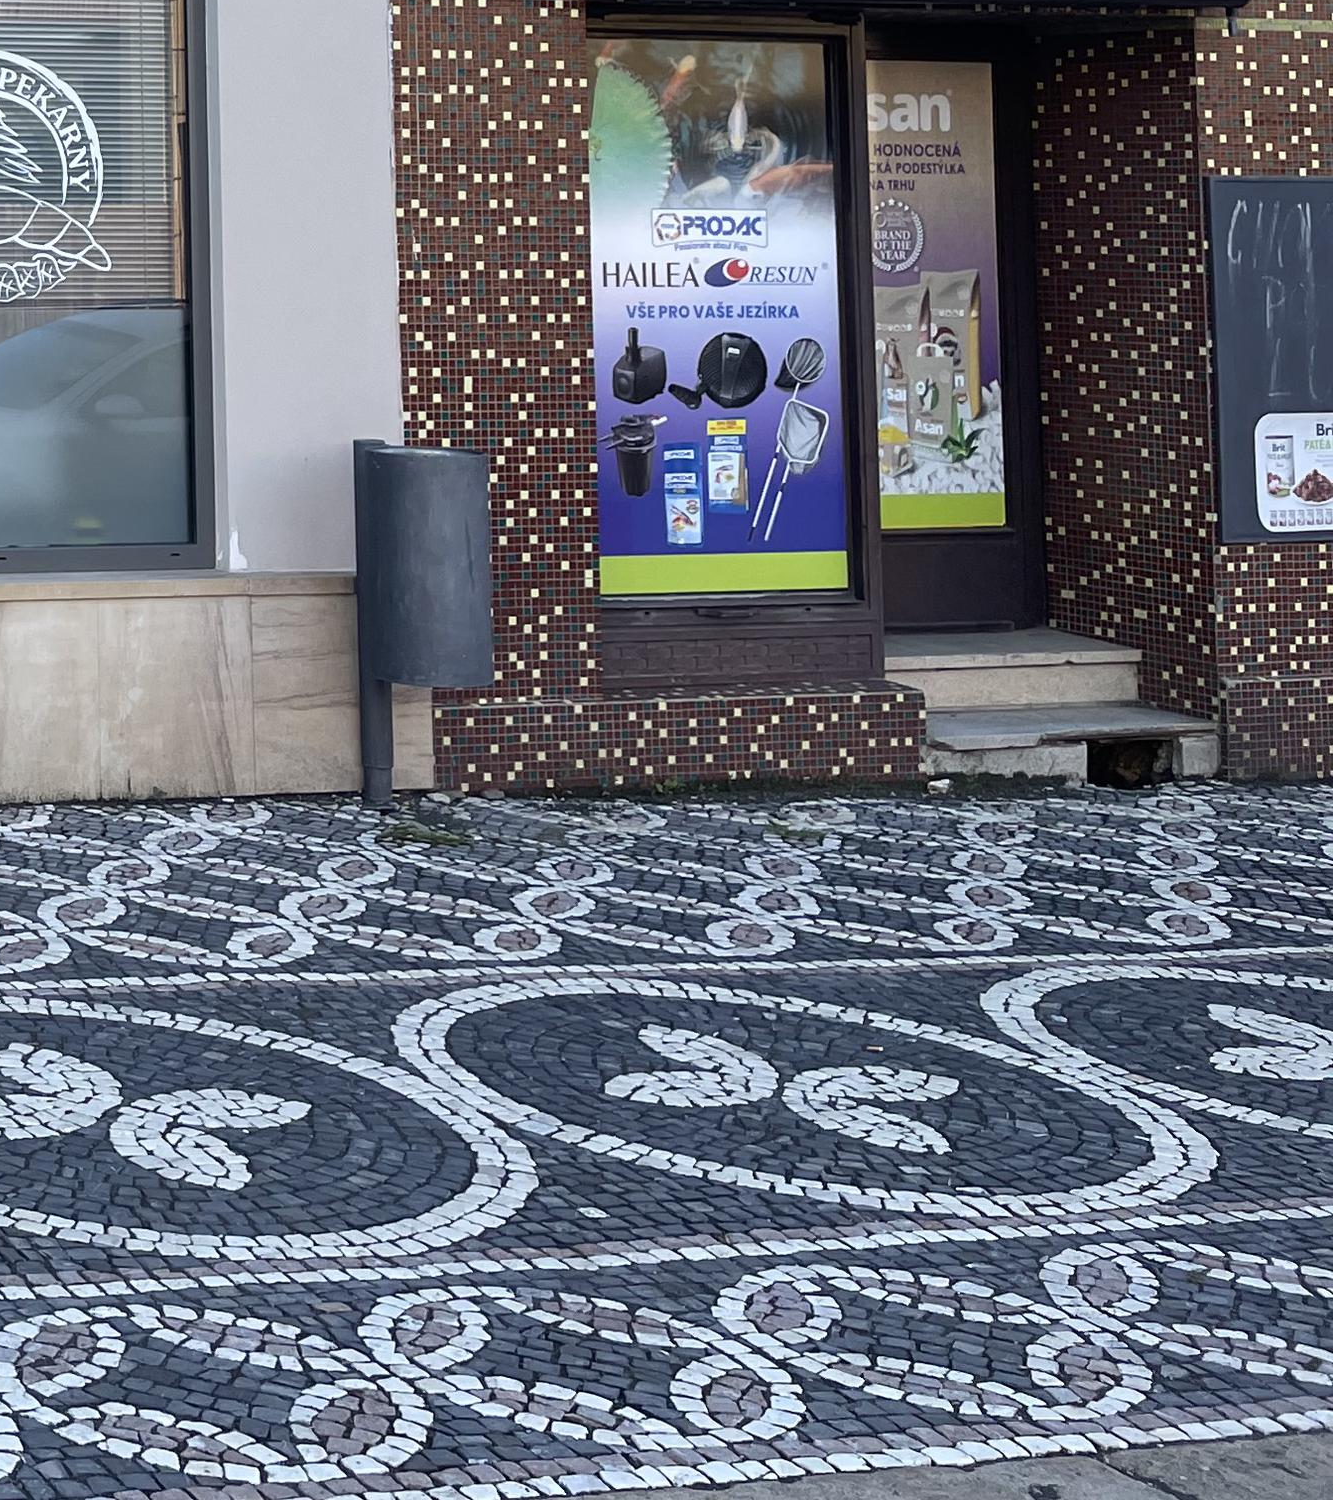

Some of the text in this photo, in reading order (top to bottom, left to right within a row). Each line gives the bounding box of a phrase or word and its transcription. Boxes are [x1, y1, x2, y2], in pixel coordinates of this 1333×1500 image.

[873, 141, 961, 157] HODNOCENÁ
[895, 160, 966, 174] PODESTÝLKA
[888, 179, 915, 191] TRHU
[682, 215, 763, 236] PRODAC
[874, 230, 911, 240] BRAND
[874, 240, 912, 250] OF THE
[880, 250, 907, 260] YEAR
[602, 262, 818, 288] HAILEA RESUN
[626, 301, 800, 319] VŠE PRO VAŠE JEZÍRKA
[915, 418, 944, 436] Asan
